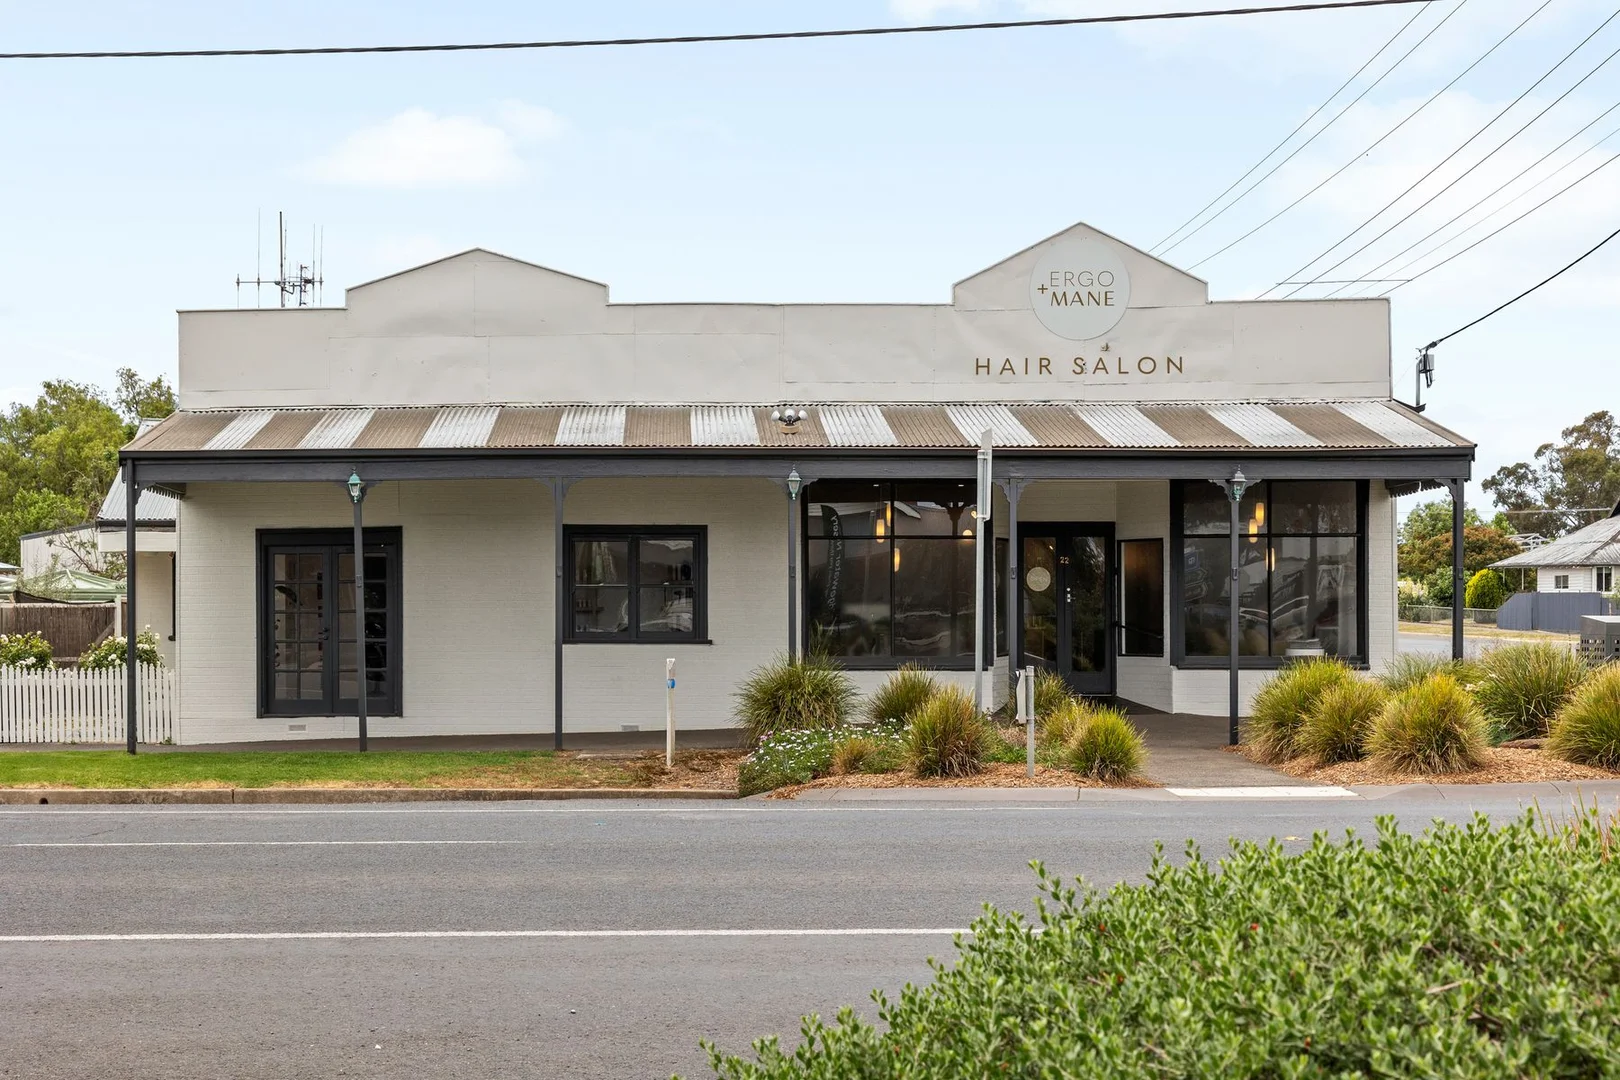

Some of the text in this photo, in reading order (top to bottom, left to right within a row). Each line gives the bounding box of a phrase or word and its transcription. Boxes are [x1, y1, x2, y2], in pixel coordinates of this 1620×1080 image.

[1050, 271, 1115, 288] ERGO
[1050, 290, 1115, 307] MANE
[975, 356, 1184, 376] HAIR SALON
[1059, 556, 1070, 565] 22
